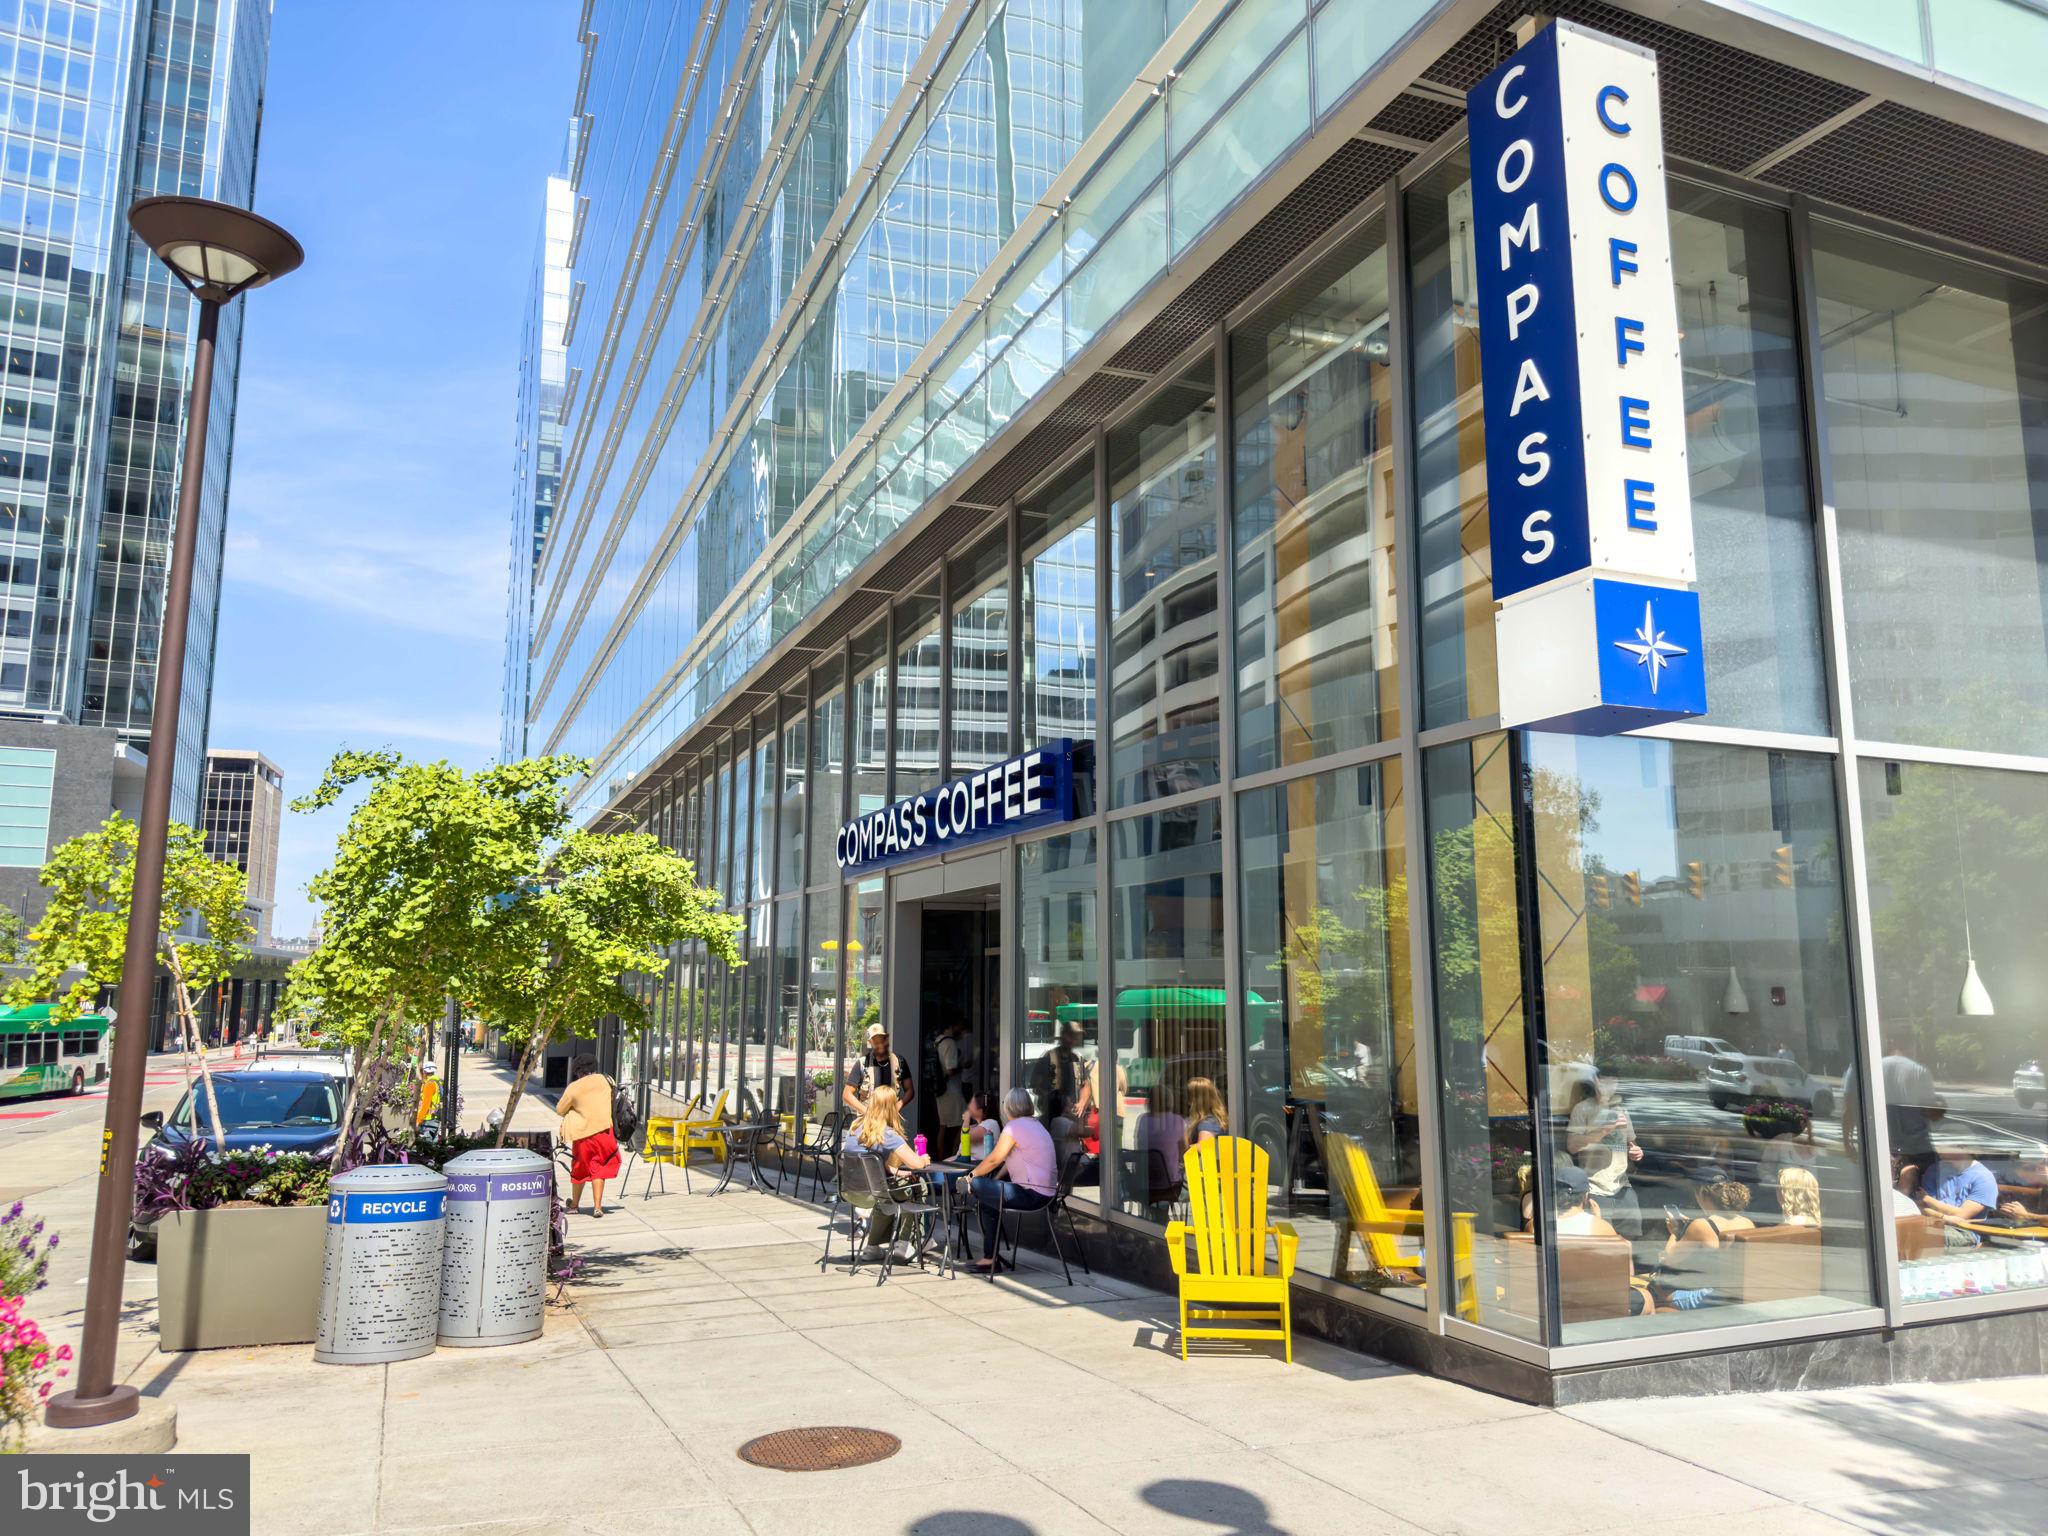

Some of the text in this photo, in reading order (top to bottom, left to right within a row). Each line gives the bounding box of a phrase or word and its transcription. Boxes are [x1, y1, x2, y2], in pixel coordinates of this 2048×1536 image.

[1496, 65, 1555, 565] COMPASS
[1596, 85, 1658, 532] COFFEE
[836, 752, 1041, 868] COMPASS COFFEE
[362, 1201, 427, 1215] RECYCLE
[502, 1181, 542, 1192] ROSSLYN
